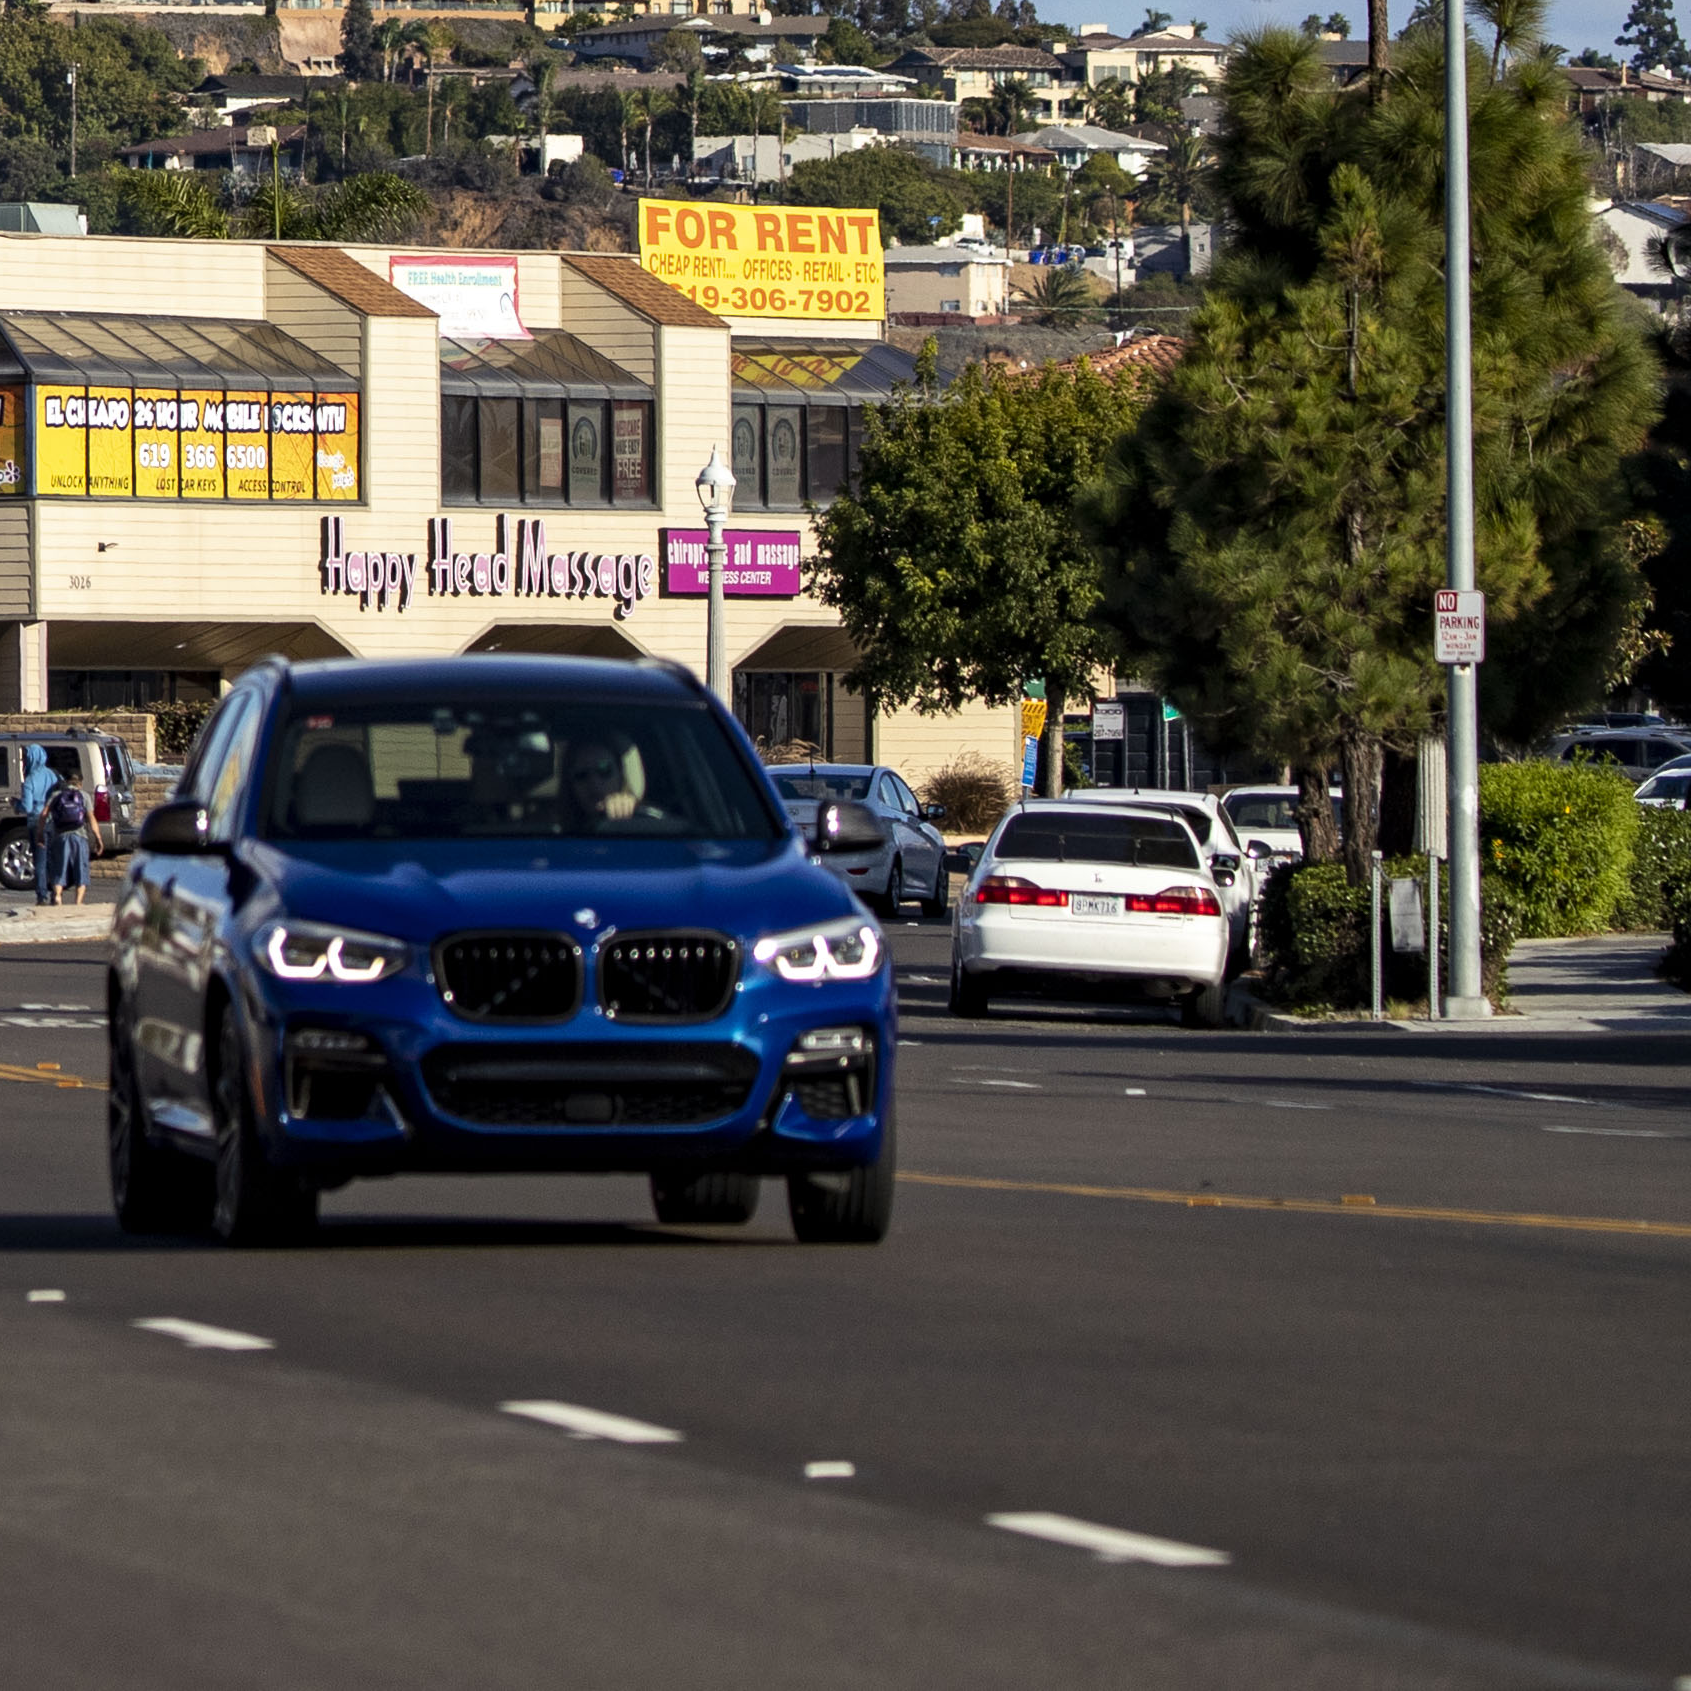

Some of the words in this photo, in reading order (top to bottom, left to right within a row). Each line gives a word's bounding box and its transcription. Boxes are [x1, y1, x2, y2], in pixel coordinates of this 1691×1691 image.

[646, 206, 738, 250] FOR
[753, 213, 875, 255] RENT
[649, 253, 690, 276] CHEAP
[743, 259, 792, 281] OFFICES
[804, 262, 844, 283] RETAIL
[669, 283, 870, 313] 19-306-7902
[46, 398, 65, 426] EL
[139, 443, 170, 468] 619
[185, 444, 216, 469] 366
[226, 445, 266, 470] 6500
[617, 459, 642, 479] FREE
[51, 475, 83, 489] UNLOCK
[89, 476, 129, 489] ANYTHING
[156, 478, 175, 491] LOST
[197, 479, 216, 492] KEYS
[323, 516, 419, 609] Happy
[430, 513, 510, 595] Head
[519, 518, 653, 618] Massage
[668, 539, 728, 569] chiroprc
[734, 540, 752, 566] and
[757, 543, 799, 570] massage
[740, 571, 772, 585] CENTER
[1439, 594, 1455, 610] NO
[1440, 616, 1480, 629] PARKING
